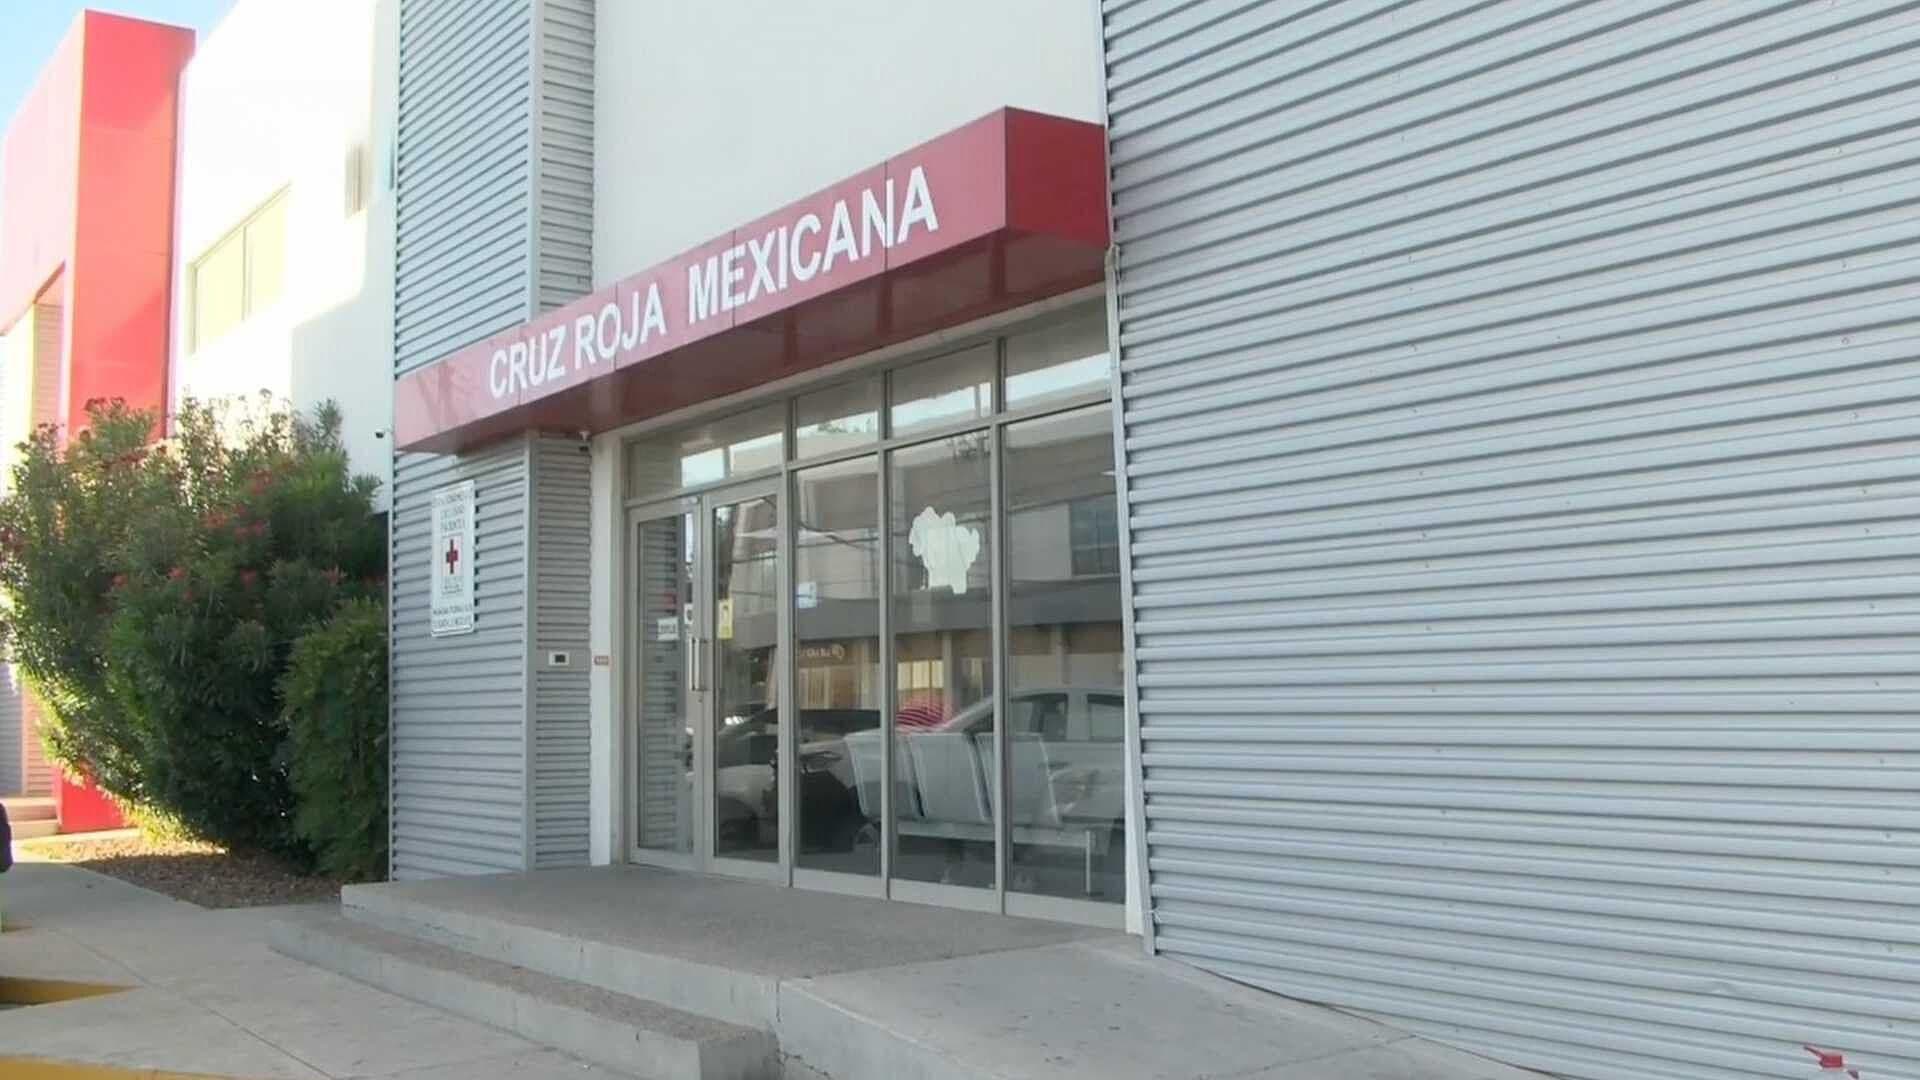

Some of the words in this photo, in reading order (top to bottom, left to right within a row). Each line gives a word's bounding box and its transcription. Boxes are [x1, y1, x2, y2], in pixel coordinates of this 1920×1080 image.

[489, 325, 565, 399] CRUZ
[575, 283, 667, 370] ROJA
[688, 165, 938, 324] MEXICANA
